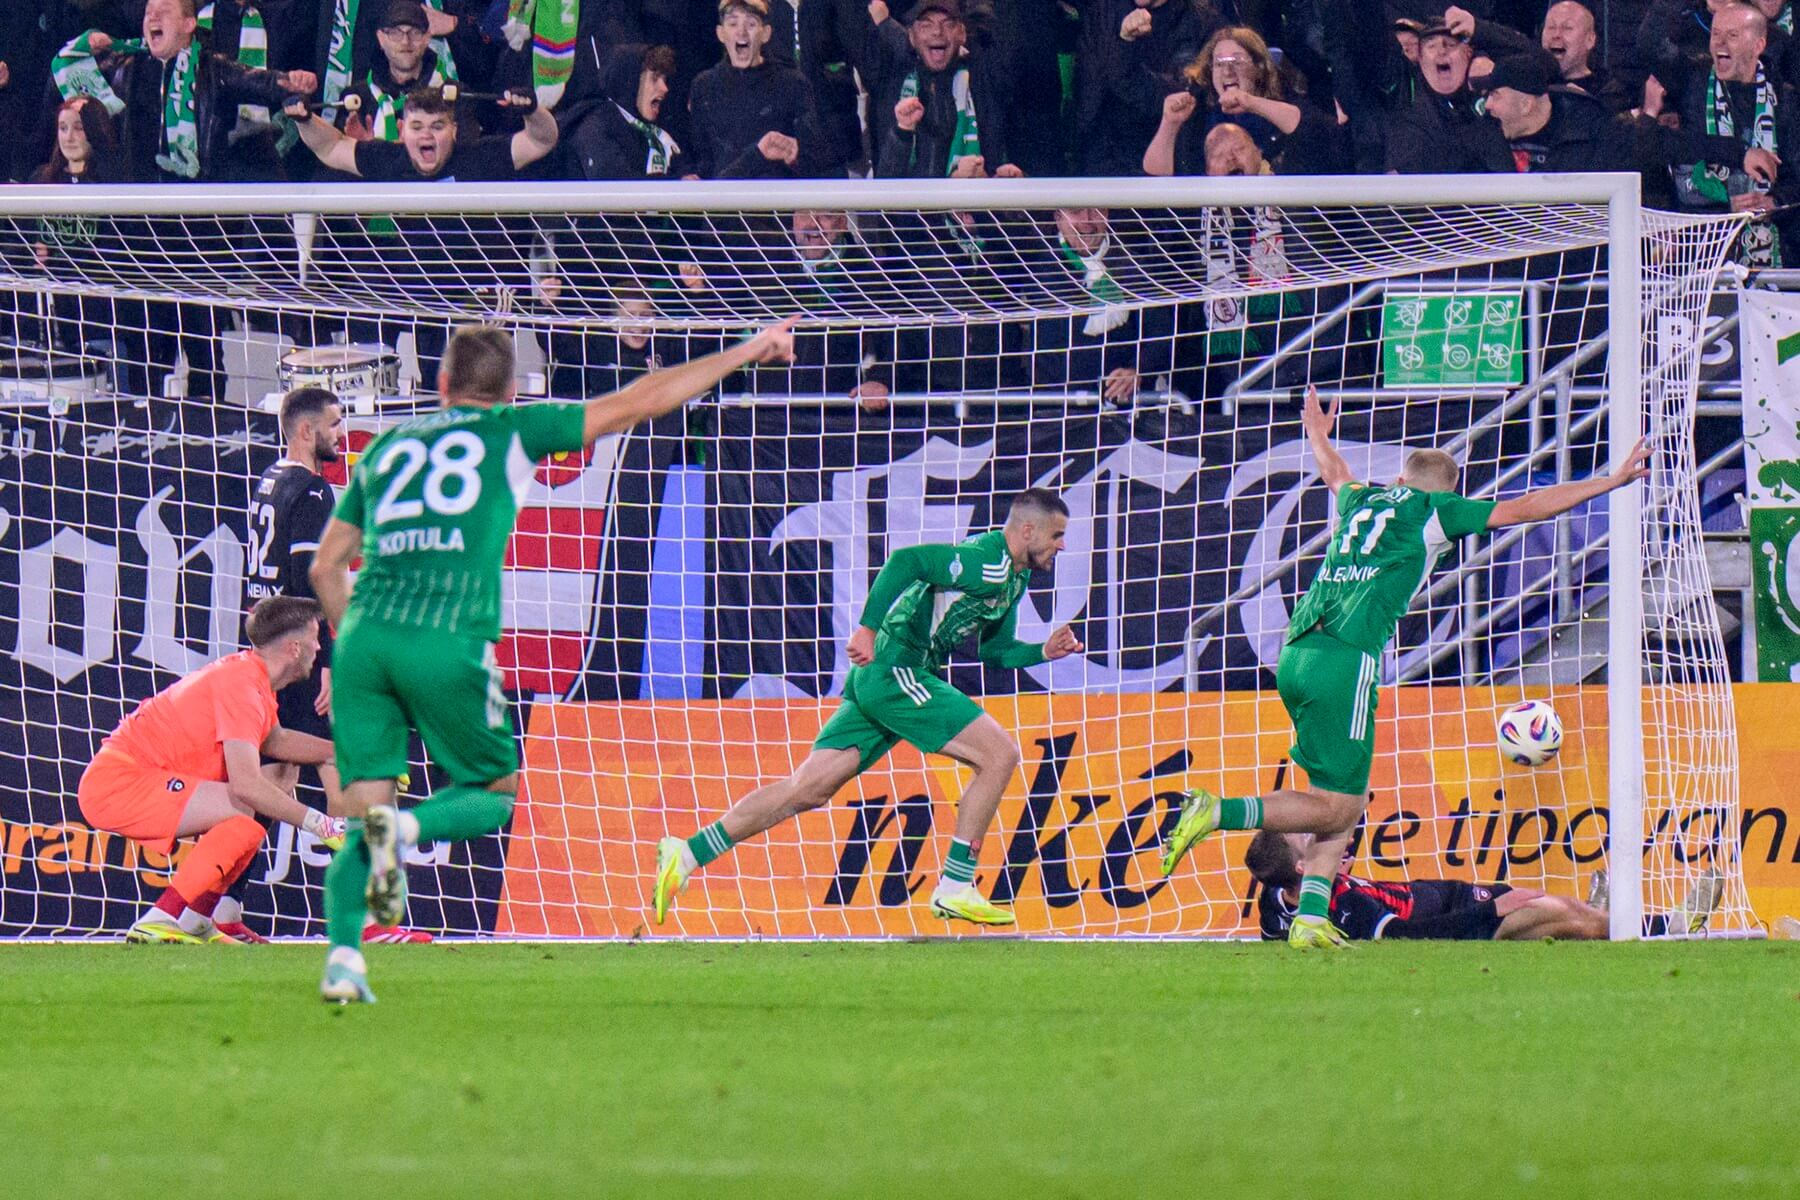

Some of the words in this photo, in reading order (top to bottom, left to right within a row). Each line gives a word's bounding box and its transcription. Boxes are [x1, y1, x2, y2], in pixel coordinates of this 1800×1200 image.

[375, 430, 485, 525] 28
[377, 527, 465, 557] KOTULA
[1340, 507, 1395, 555] 11
[824, 731, 1194, 908] nké
[1448, 788, 1800, 883] tipoan
[0, 822, 196, 888] rang
